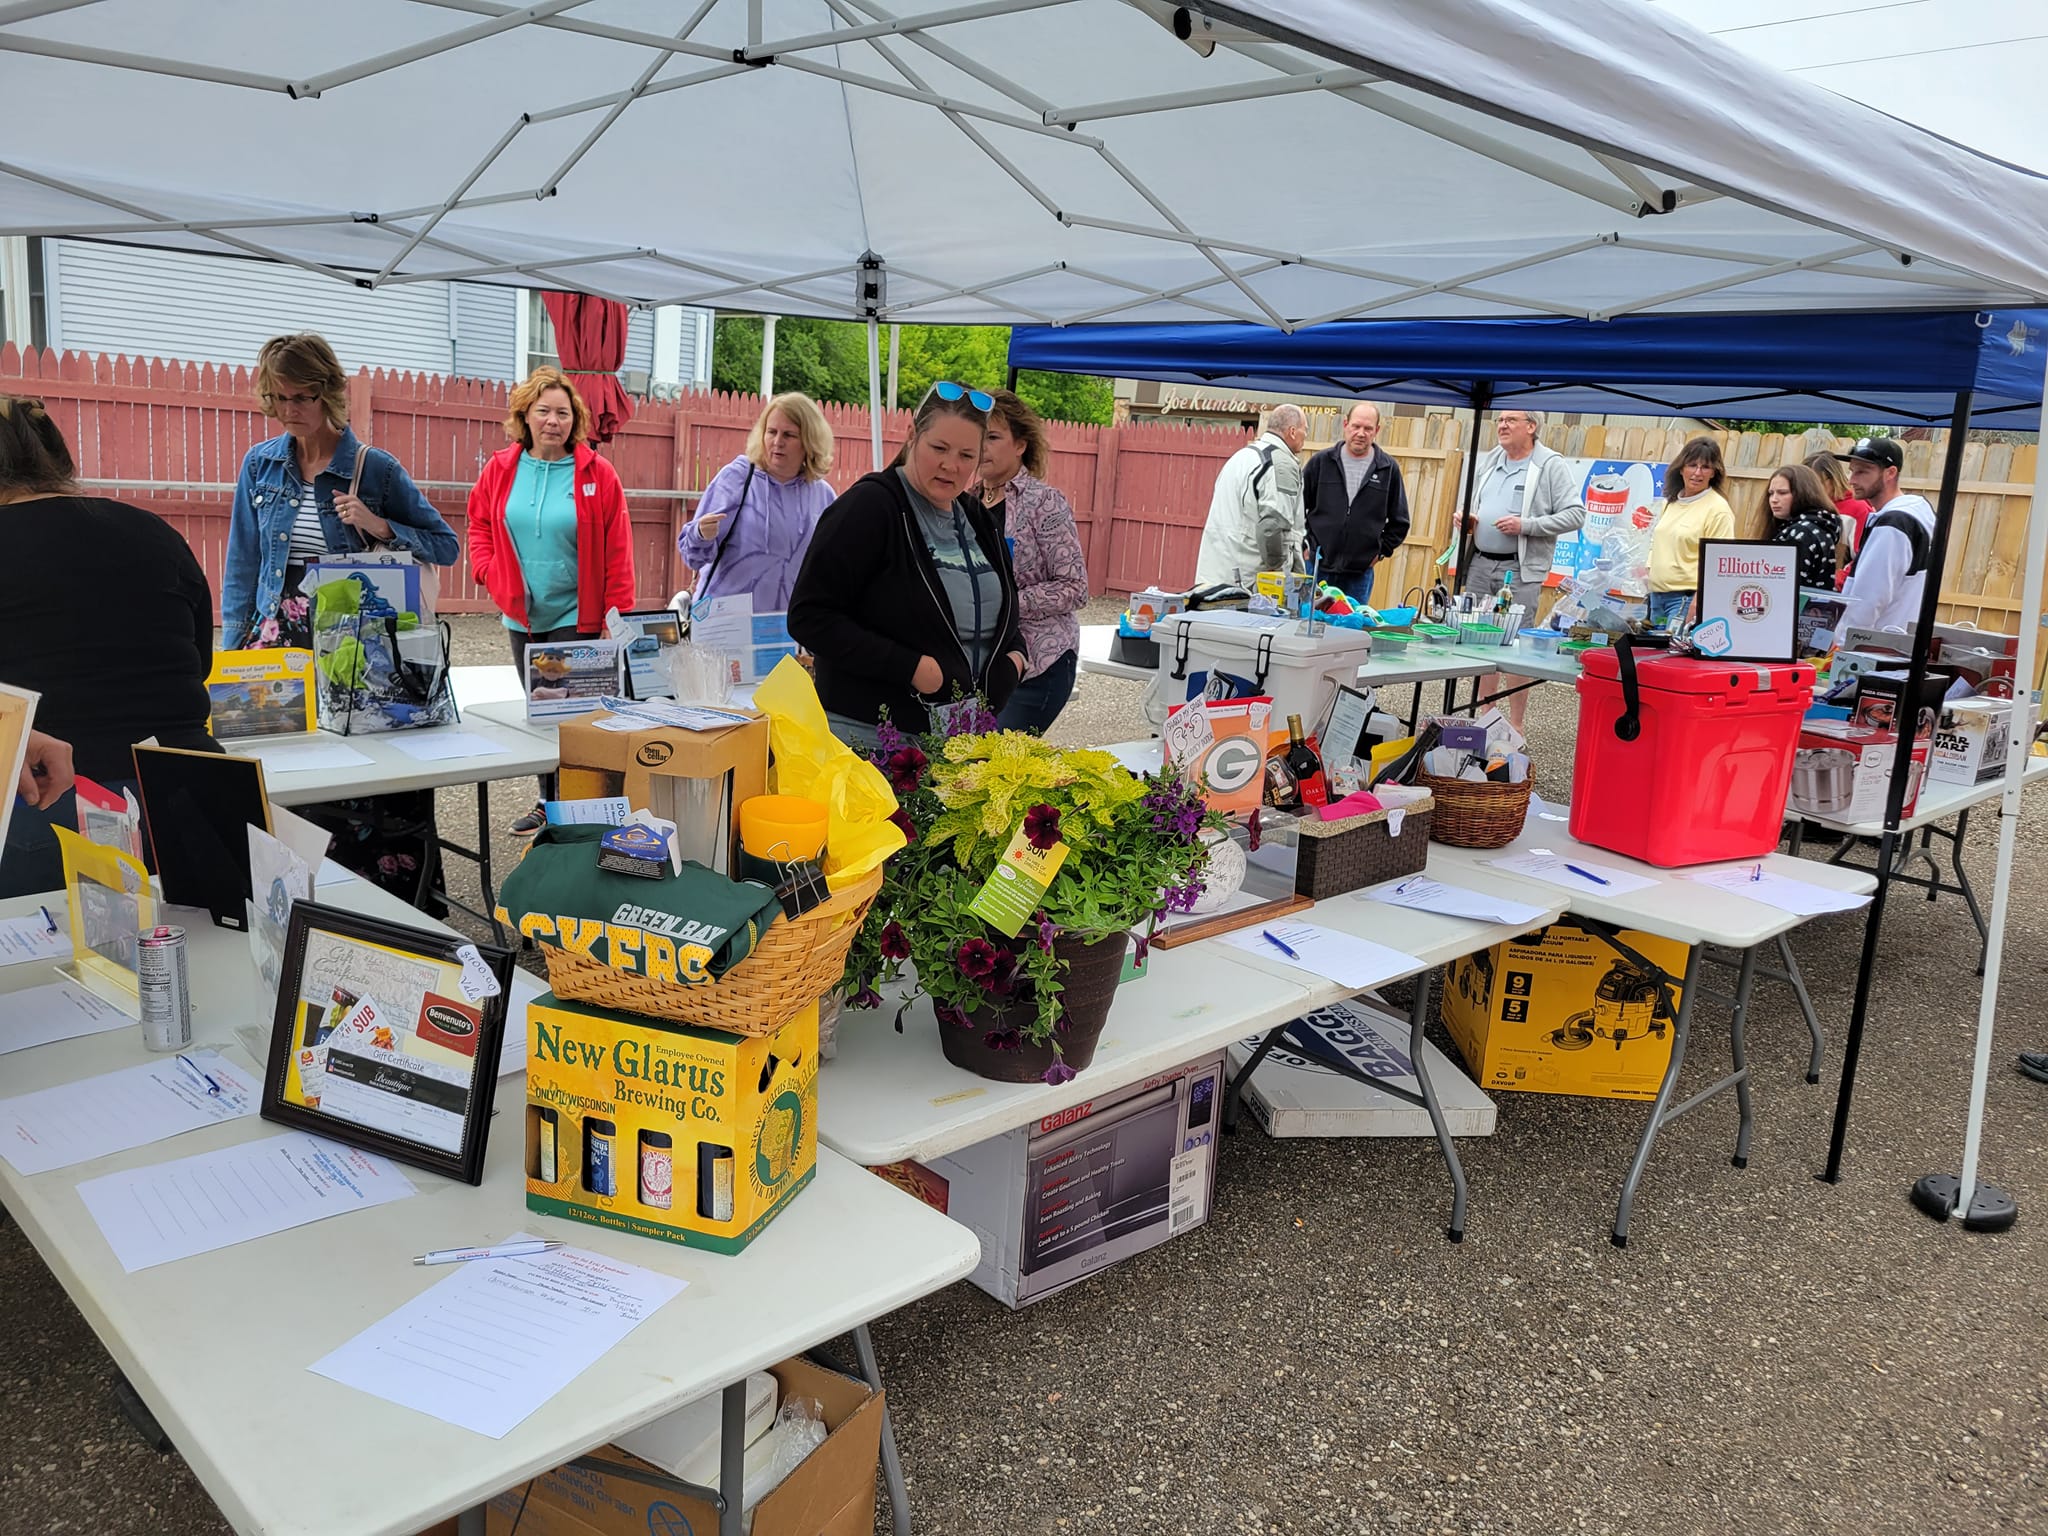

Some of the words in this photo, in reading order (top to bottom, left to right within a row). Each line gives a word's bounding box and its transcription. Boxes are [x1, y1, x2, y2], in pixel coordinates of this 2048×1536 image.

[1161, 386, 1188, 415] Joe
[1189, 390, 1248, 413] Kumba
[582, 482, 597, 497] W
[1588, 502, 1625, 514] SMIRNOFF
[1554, 550, 1575, 559] EVEAL
[1555, 541, 1570, 551] OLD
[1718, 557, 1770, 576] Elliott's
[1740, 591, 1762, 608] 60
[1936, 732, 1970, 746] STAR
[647, 750, 668, 761] cellar
[1026, 842, 1048, 860] SUN
[612, 903, 682, 935] GREEN
[678, 920, 727, 946] BAY
[1513, 975, 1525, 988] 9
[1509, 1000, 1521, 1013] 5
[352, 1004, 376, 1034] SUB
[429, 1008, 472, 1031] Benvenuto's
[1368, 1031, 1394, 1051] BAG
[372, 1050, 388, 1062] Gift
[387, 1054, 425, 1073] Certificate
[534, 1020, 607, 1071] New
[612, 1039, 726, 1098] Glarus
[655, 1045, 695, 1062] Employee
[695, 1051, 726, 1068] Owned
[1161, 1070, 1183, 1084] Toaster
[1183, 1065, 1199, 1076] Oven
[535, 1086, 556, 1101] ONLY
[567, 1093, 616, 1115] WISCONSIN
[613, 1078, 687, 1121] Brewing
[691, 1096, 723, 1124] Co.
[761, 1080, 787, 1115] Glarus
[1040, 1101, 1094, 1134] Galanz
[1043, 1160, 1068, 1176] Enhanced
[1084, 1142, 1112, 1157] Technology
[1042, 1188, 1059, 1200] Create
[1059, 1177, 1081, 1193] Gourmet
[1081, 1171, 1091, 1182] and
[1090, 1164, 1110, 1177] Healthy
[1040, 1213, 1053, 1224] Even
[1052, 1202, 1075, 1218] Roasting
[1074, 1197, 1085, 1207] and
[1085, 1190, 1102, 1202] Baking
[566, 1205, 600, 1222] 12/12oz.
[599, 1213, 627, 1230] Bottles
[631, 1221, 666, 1238] Sampler
[666, 1230, 687, 1243] Pack
[1038, 1236, 1052, 1248] Cook
[1052, 1232, 1059, 1241] up
[1074, 1217, 1091, 1230] pound
[1090, 1209, 1110, 1223] Chicken
[1080, 1250, 1108, 1269] Galanz
